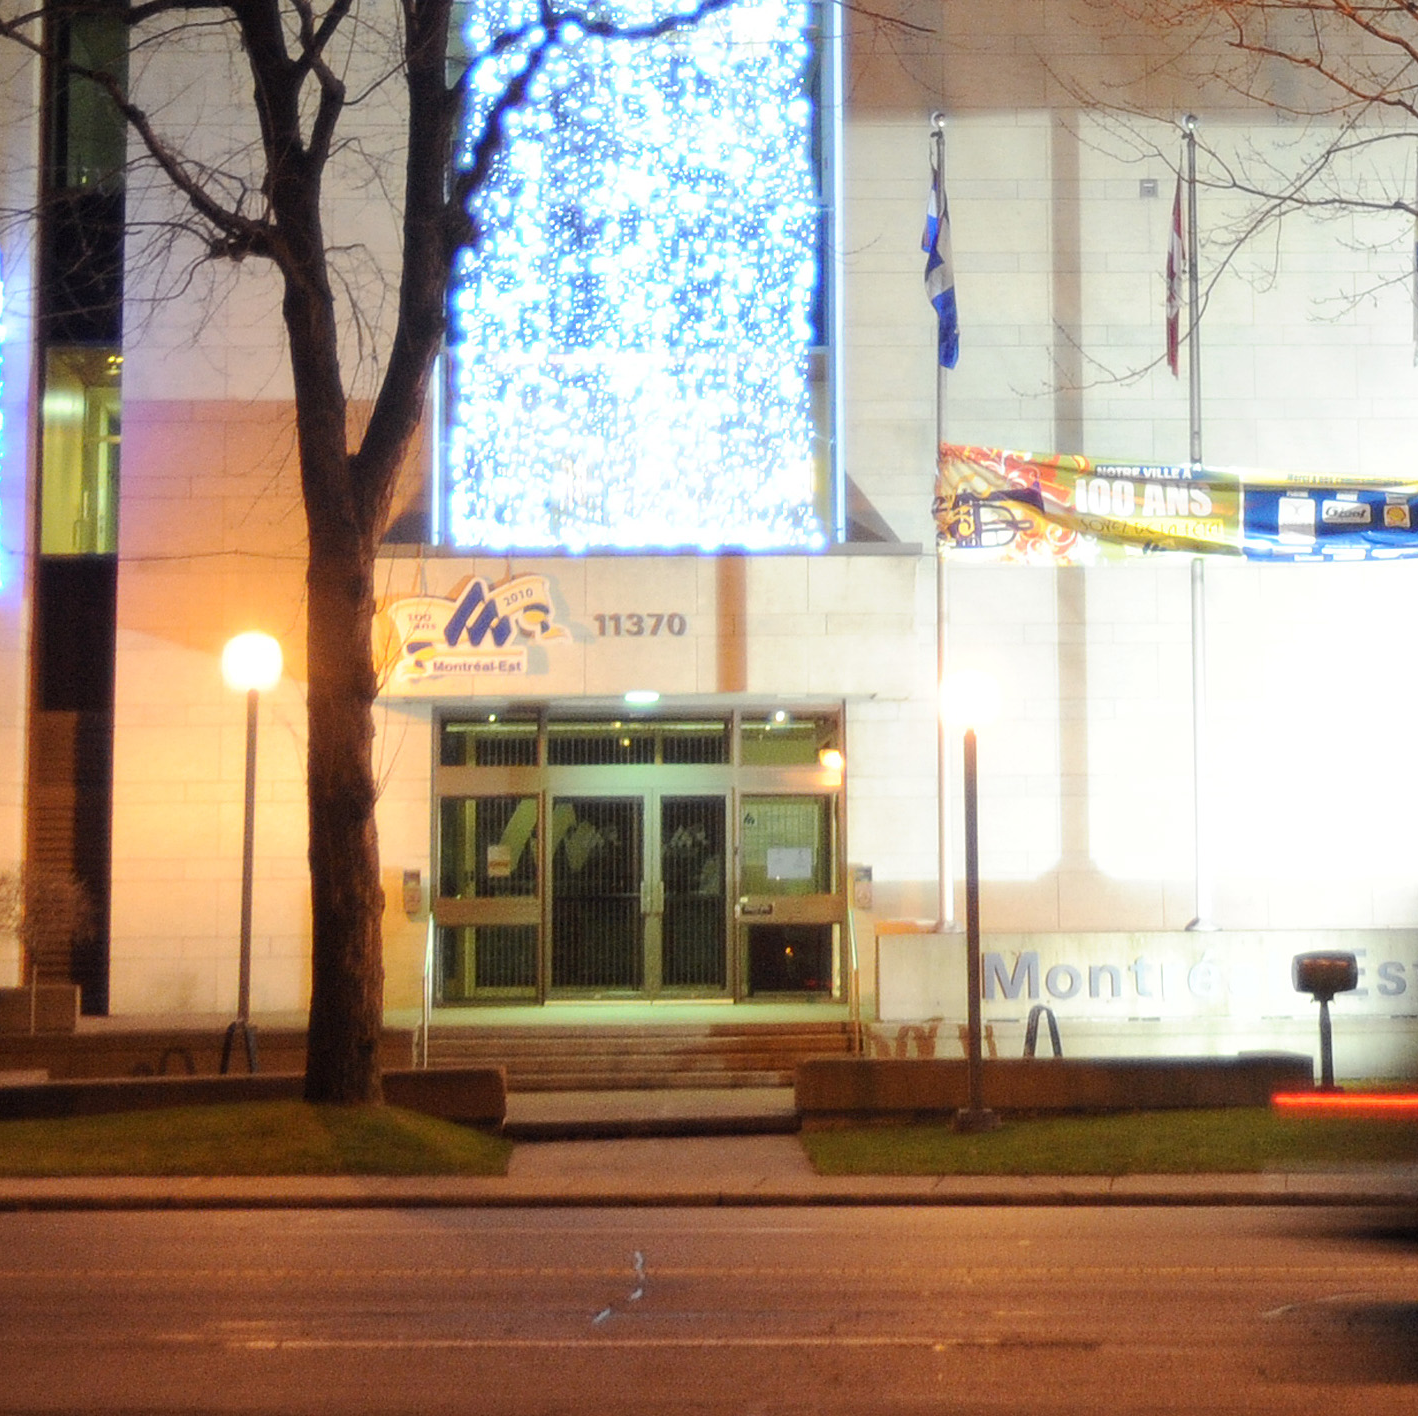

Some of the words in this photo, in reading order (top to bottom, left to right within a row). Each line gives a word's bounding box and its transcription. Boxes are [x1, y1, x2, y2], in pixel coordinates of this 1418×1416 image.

[1096, 466, 1141, 479] NOTRE
[1143, 466, 1179, 480] VILLE
[1075, 478, 1136, 517] 100
[1141, 480, 1213, 517] ANS
[503, 588, 534, 606] 2010
[593, 612, 688, 637] 11370
[433, 659, 522, 673] Montréal-Est
